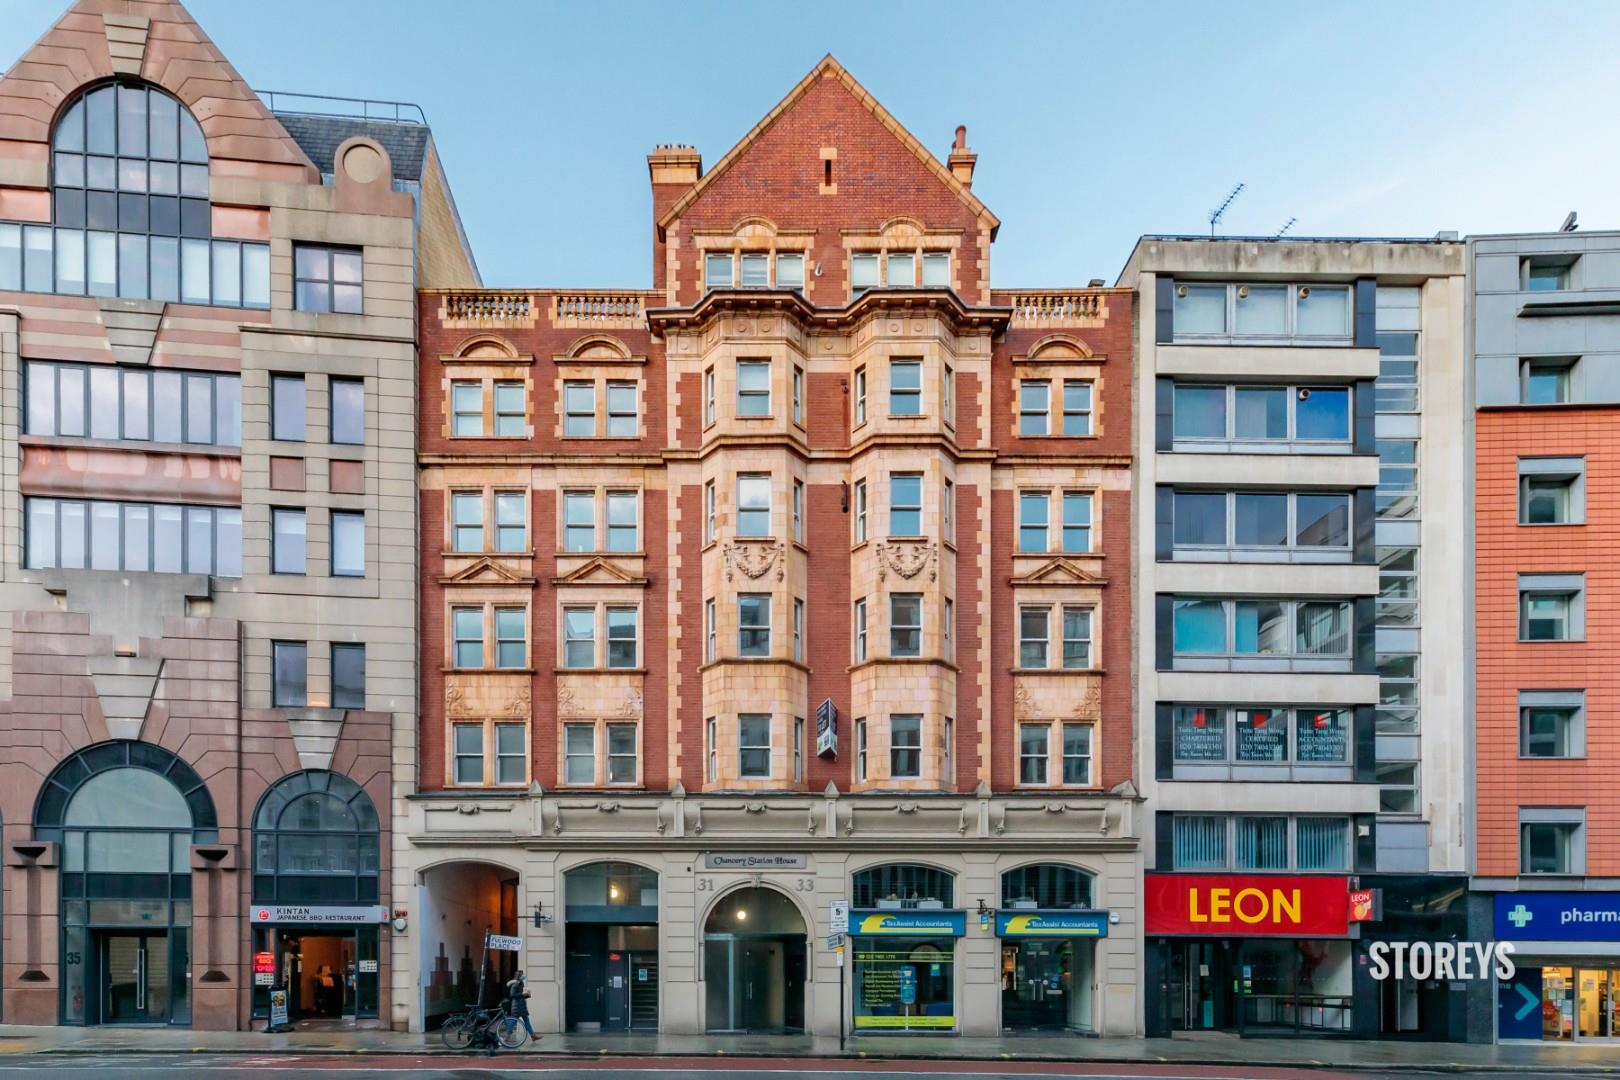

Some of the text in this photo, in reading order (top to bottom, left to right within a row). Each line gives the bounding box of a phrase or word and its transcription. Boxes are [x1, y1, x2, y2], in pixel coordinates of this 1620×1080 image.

[714, 856, 798, 866] Chancery Station House
[697, 879, 714, 891] 31
[796, 879, 815, 891] 33
[1351, 893, 1370, 902] LEON
[1189, 887, 1301, 923] LEON
[1560, 907, 1620, 925] pharm
[67, 951, 81, 965] 35
